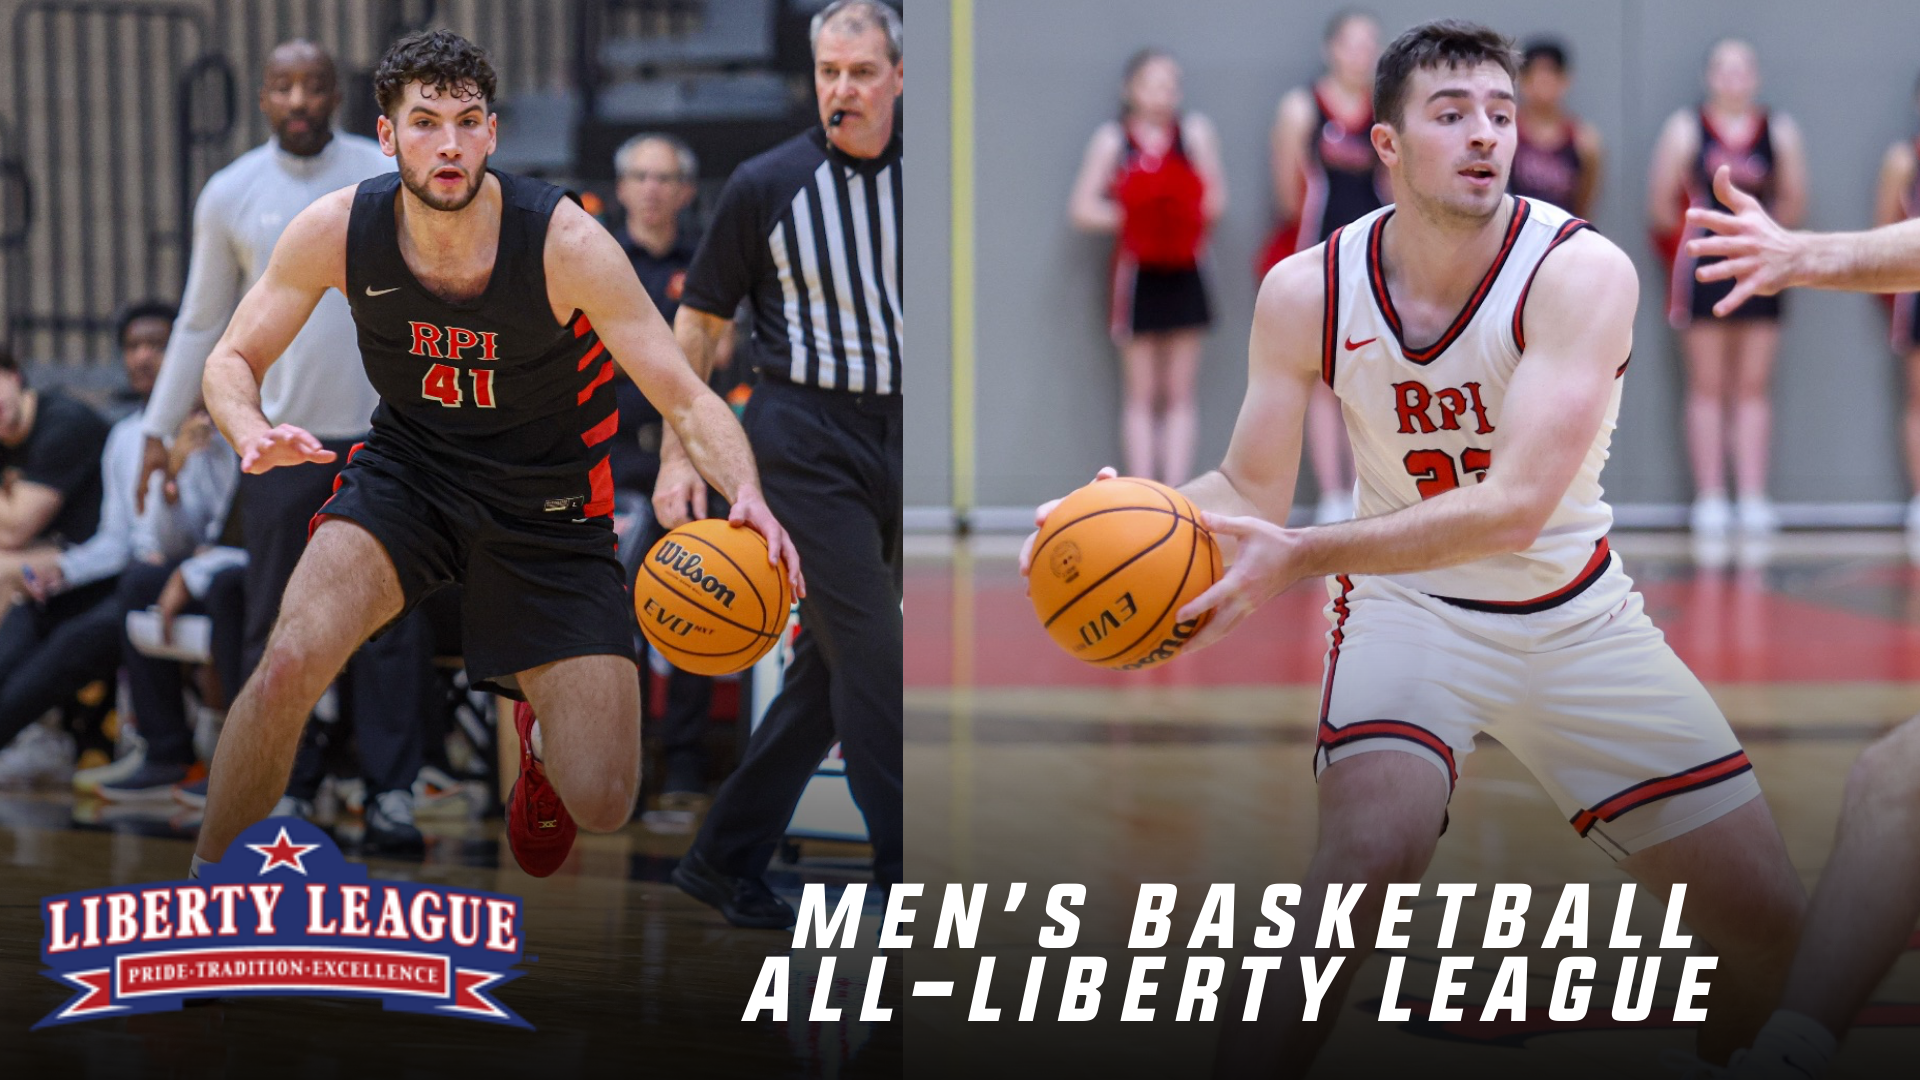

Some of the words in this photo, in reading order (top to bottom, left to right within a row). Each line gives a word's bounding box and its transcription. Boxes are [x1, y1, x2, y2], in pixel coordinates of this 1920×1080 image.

[408, 321, 500, 361] RPI
[421, 363, 496, 409] 41
[1390, 380, 1496, 435] RPI
[654, 540, 736, 609] Wilson
[643, 597, 694, 636] EVO
